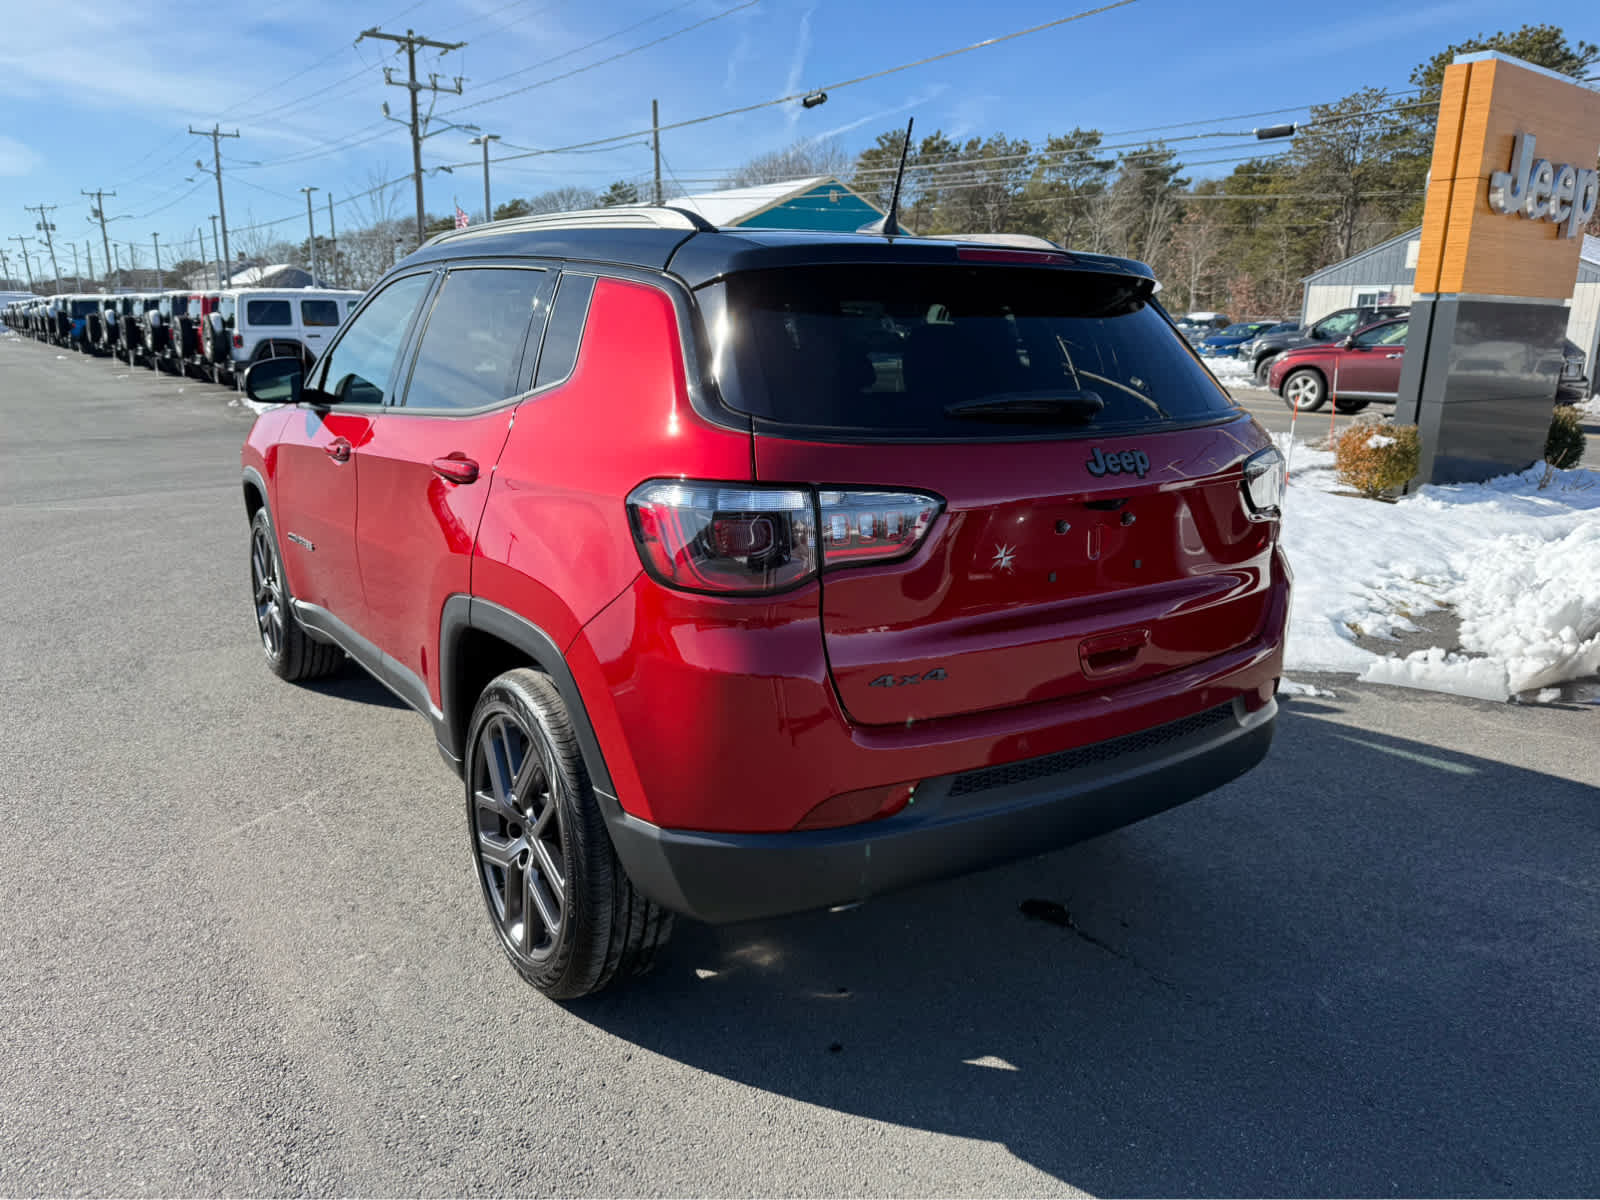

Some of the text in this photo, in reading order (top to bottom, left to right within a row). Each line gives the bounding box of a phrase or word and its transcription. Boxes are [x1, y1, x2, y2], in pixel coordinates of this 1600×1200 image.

[1489, 132, 1598, 238] Jeep
[1086, 447, 1150, 478] Jeep
[868, 668, 948, 688] 4x4
